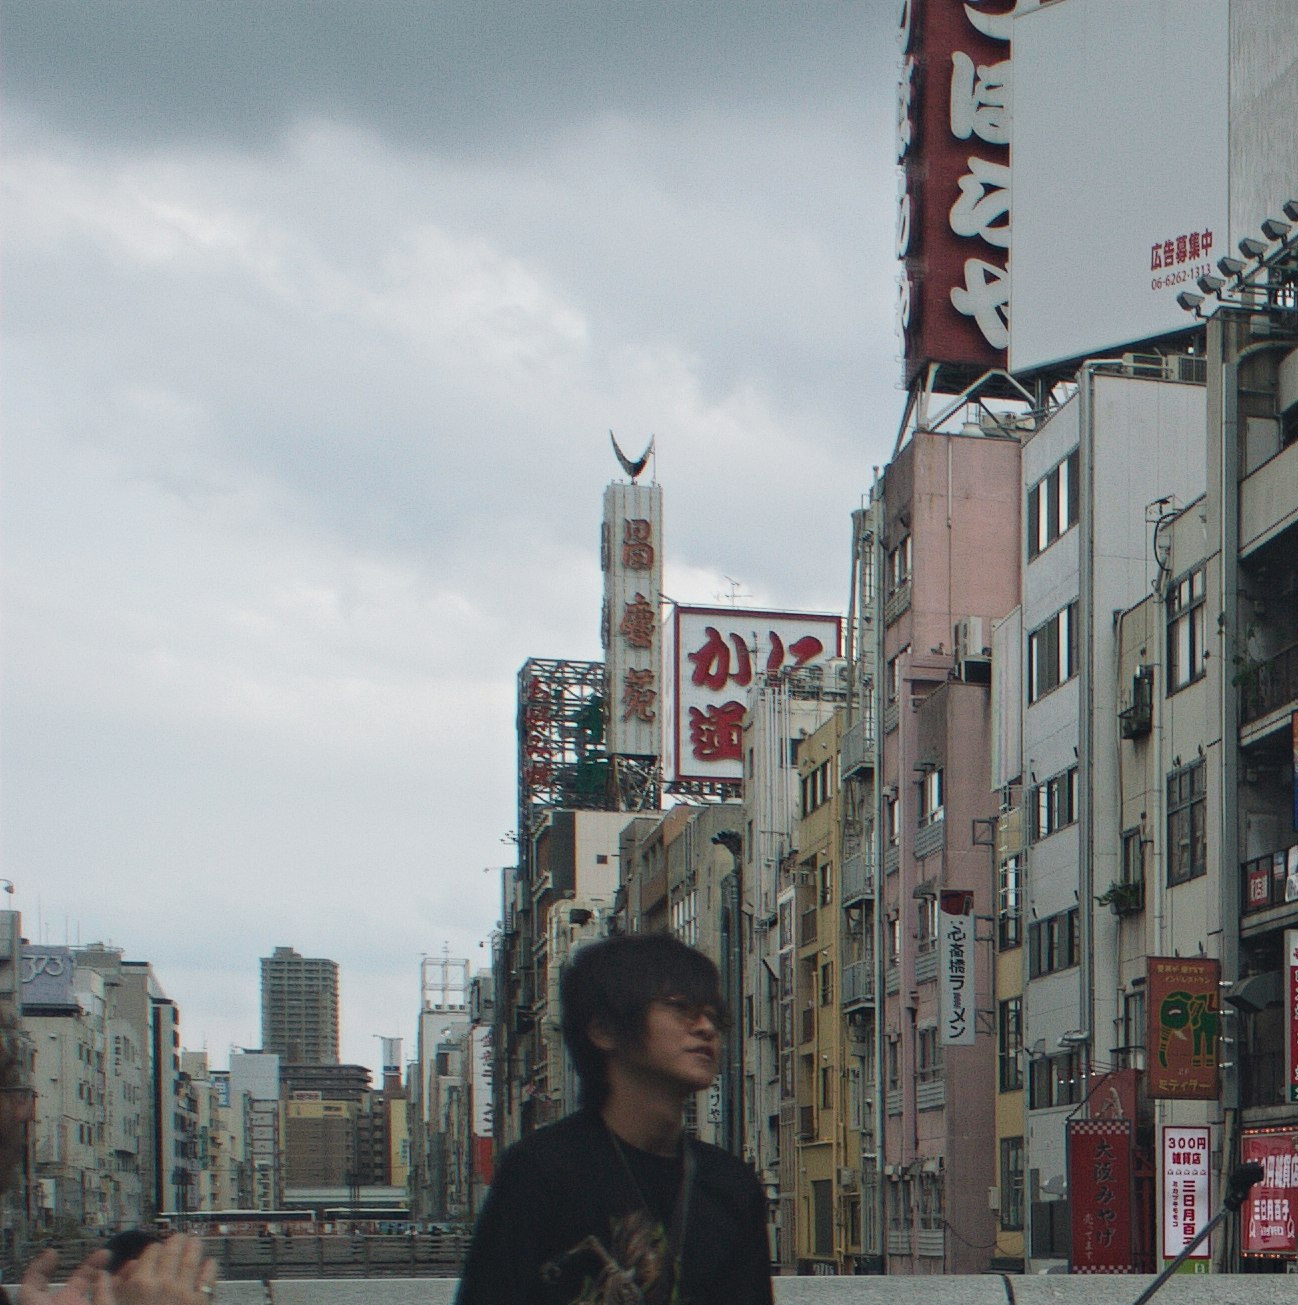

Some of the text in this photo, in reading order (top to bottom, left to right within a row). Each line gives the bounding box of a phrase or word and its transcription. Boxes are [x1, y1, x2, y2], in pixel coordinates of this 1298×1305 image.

[1151, 228, 1212, 271] 広告募集中
[946, 925, 967, 1039] 心斎橋ラーメン
[1168, 1137, 1206, 1150] 300円
[1093, 1138, 1118, 1249] 大阪みやげ
